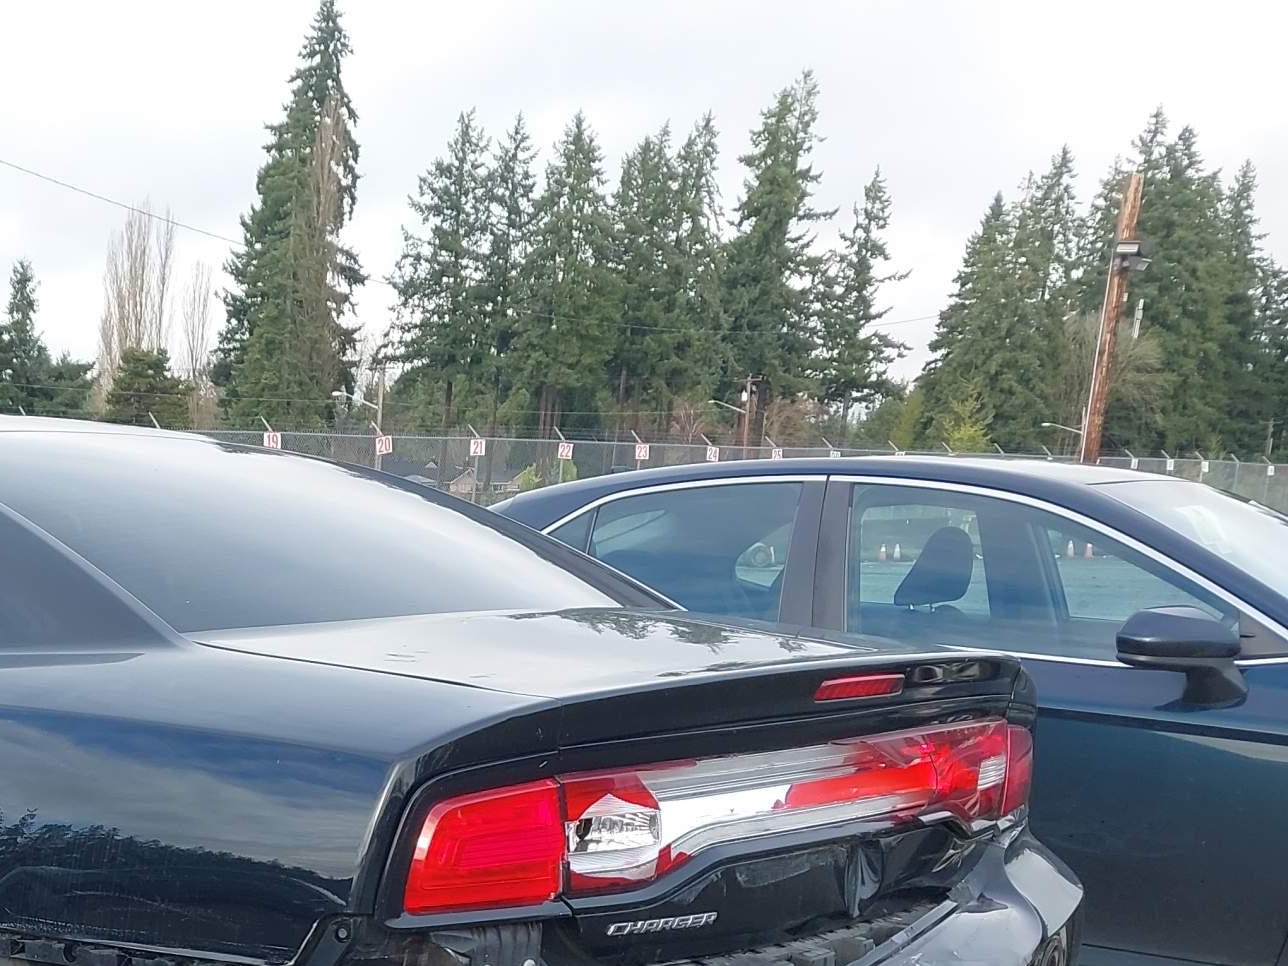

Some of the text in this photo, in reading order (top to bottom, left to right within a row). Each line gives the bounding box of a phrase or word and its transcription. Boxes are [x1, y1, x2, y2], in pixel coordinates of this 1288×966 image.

[266, 434, 279, 448] 19
[378, 437, 391, 453] 20
[473, 441, 483, 454] 21
[559, 444, 571, 458] 22
[637, 445, 647, 458] 23
[708, 449, 717, 460] 24
[607, 912, 718, 936] CHARGER
